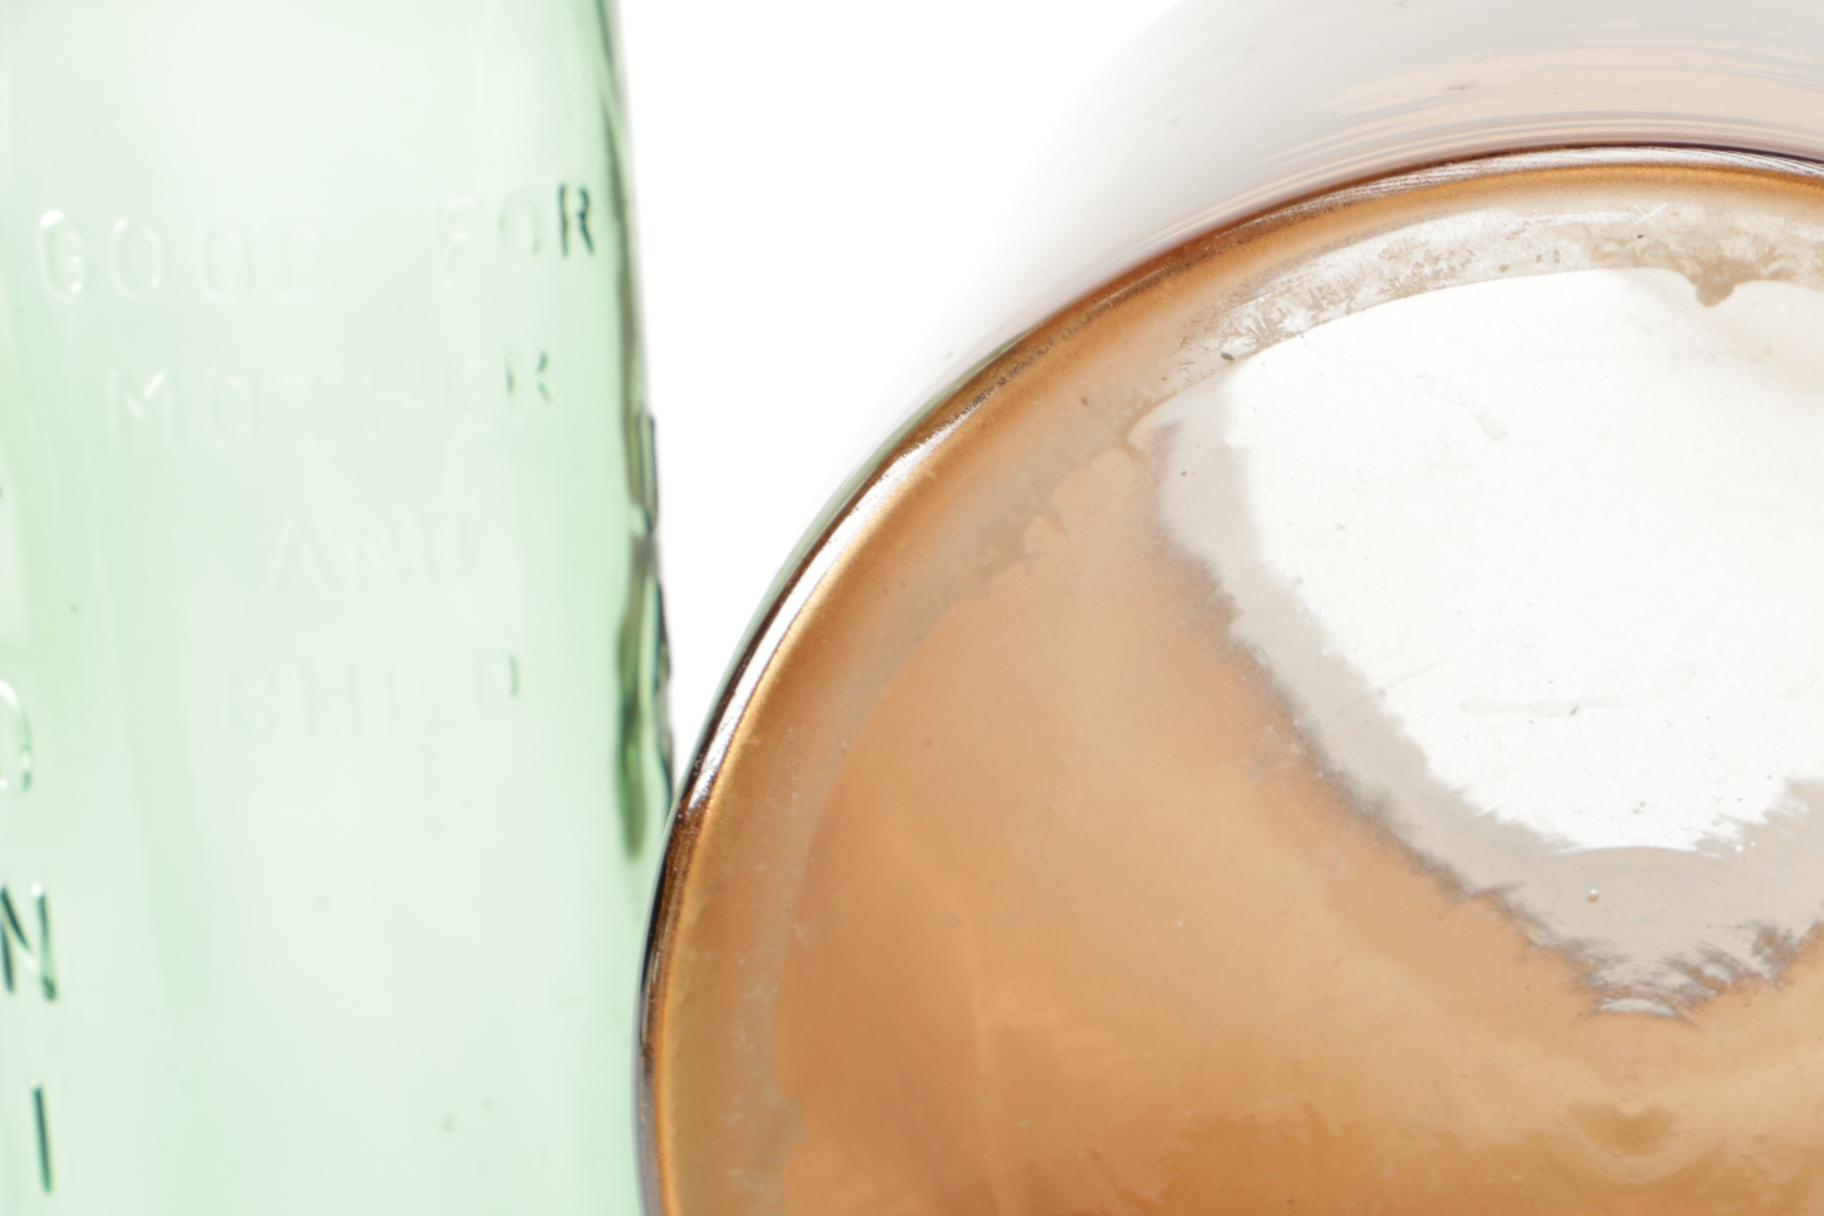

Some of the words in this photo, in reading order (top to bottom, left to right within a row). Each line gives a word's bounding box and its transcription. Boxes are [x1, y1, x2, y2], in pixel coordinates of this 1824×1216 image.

[36, 205, 322, 303] GOOD
[437, 178, 598, 290] FOR
[263, 498, 478, 596] AND
